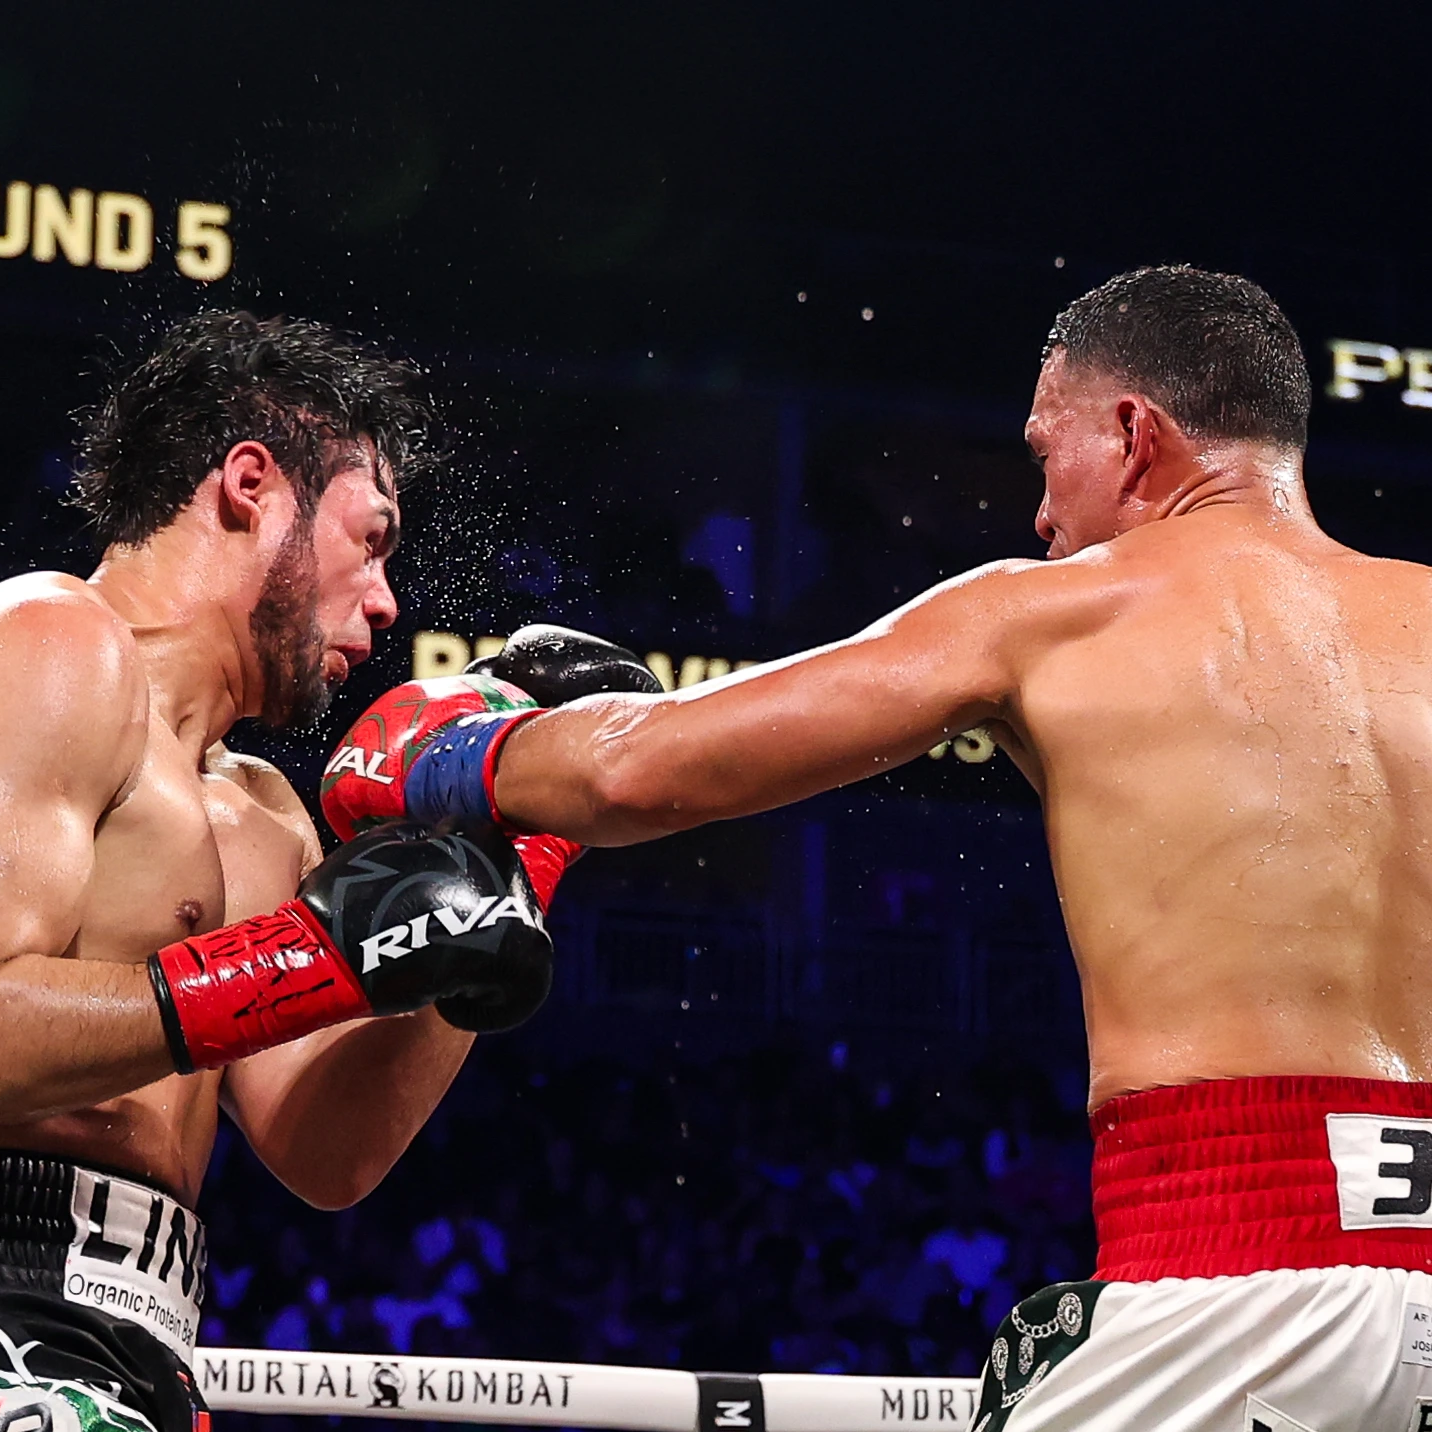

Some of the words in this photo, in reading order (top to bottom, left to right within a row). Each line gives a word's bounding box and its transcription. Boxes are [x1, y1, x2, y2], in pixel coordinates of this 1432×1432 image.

[175, 201, 233, 280] 5
[359, 896, 544, 974] RIVA
[81, 1180, 207, 1306] LIN
[68, 1274, 143, 1313] Organic
[146, 1295, 182, 1337] Protein
[202, 1359, 360, 1399] MORTAL
[417, 1368, 574, 1409] KOMBAT
[881, 1388, 977, 1421] MORT
